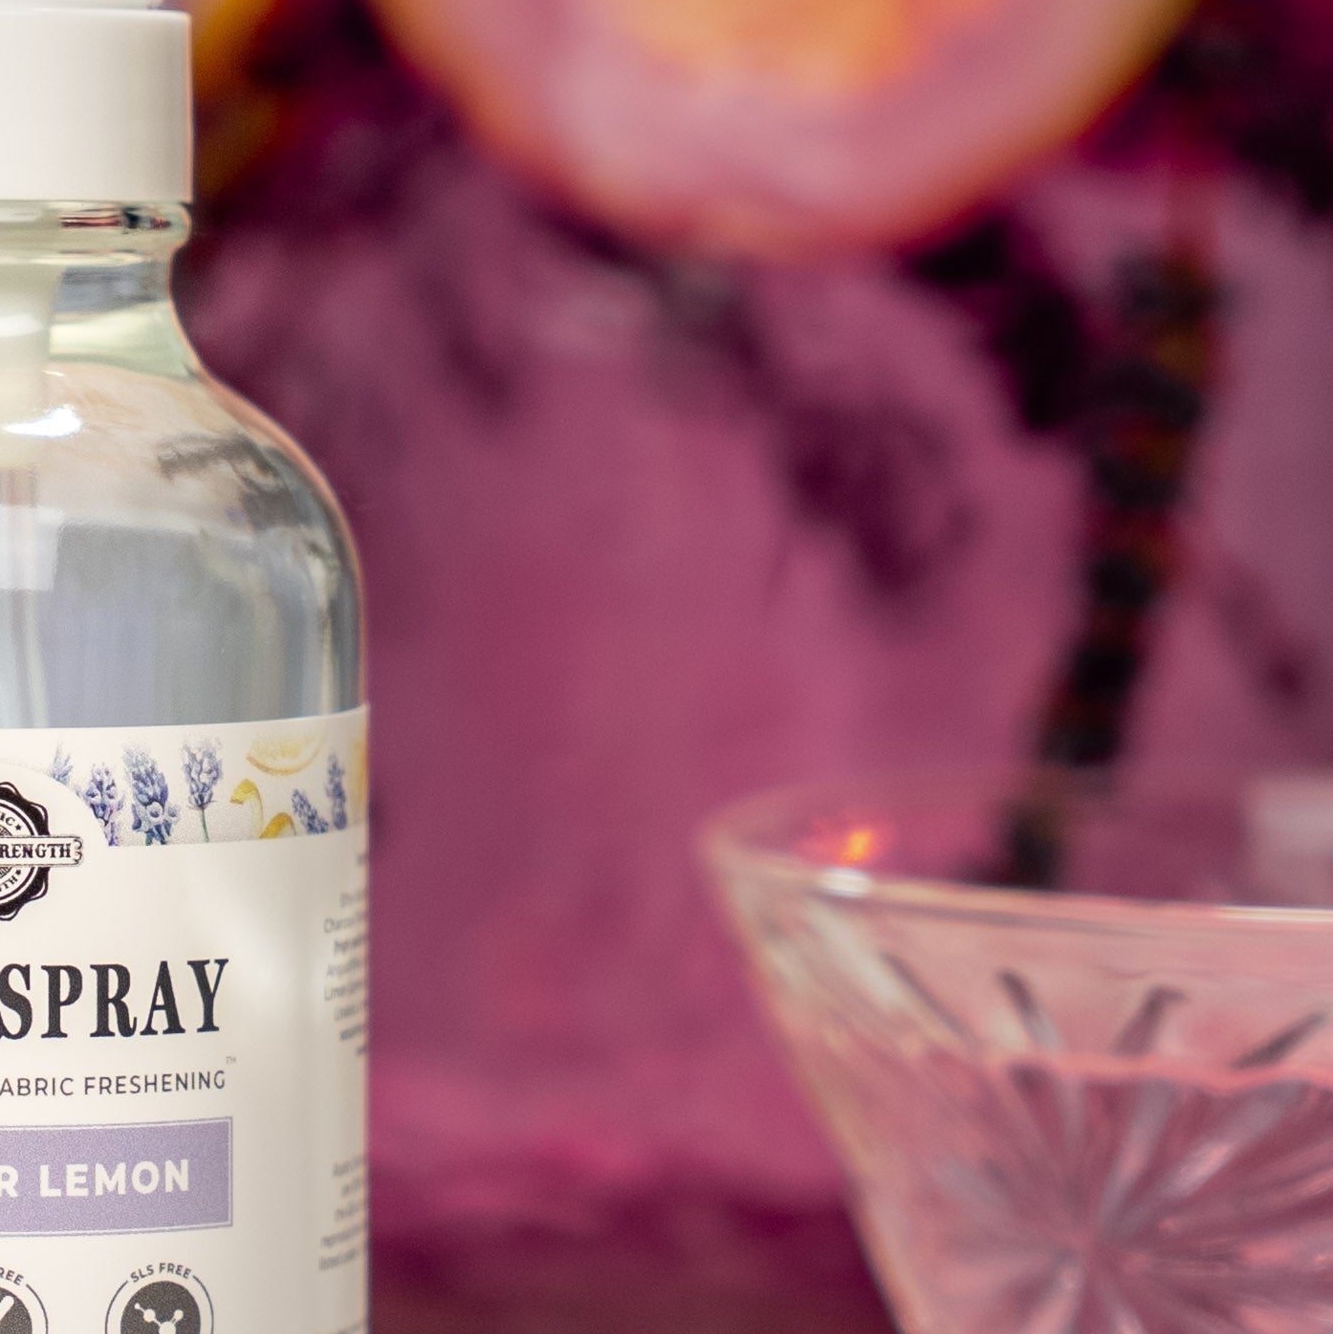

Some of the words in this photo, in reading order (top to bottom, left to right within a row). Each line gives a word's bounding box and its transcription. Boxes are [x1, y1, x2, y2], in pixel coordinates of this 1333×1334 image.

[84, 1070, 227, 1096] FRESHENING
[39, 1158, 191, 1199] LEMON
[130, 1264, 155, 1283] SLS
[158, 1262, 192, 1279] FREE
